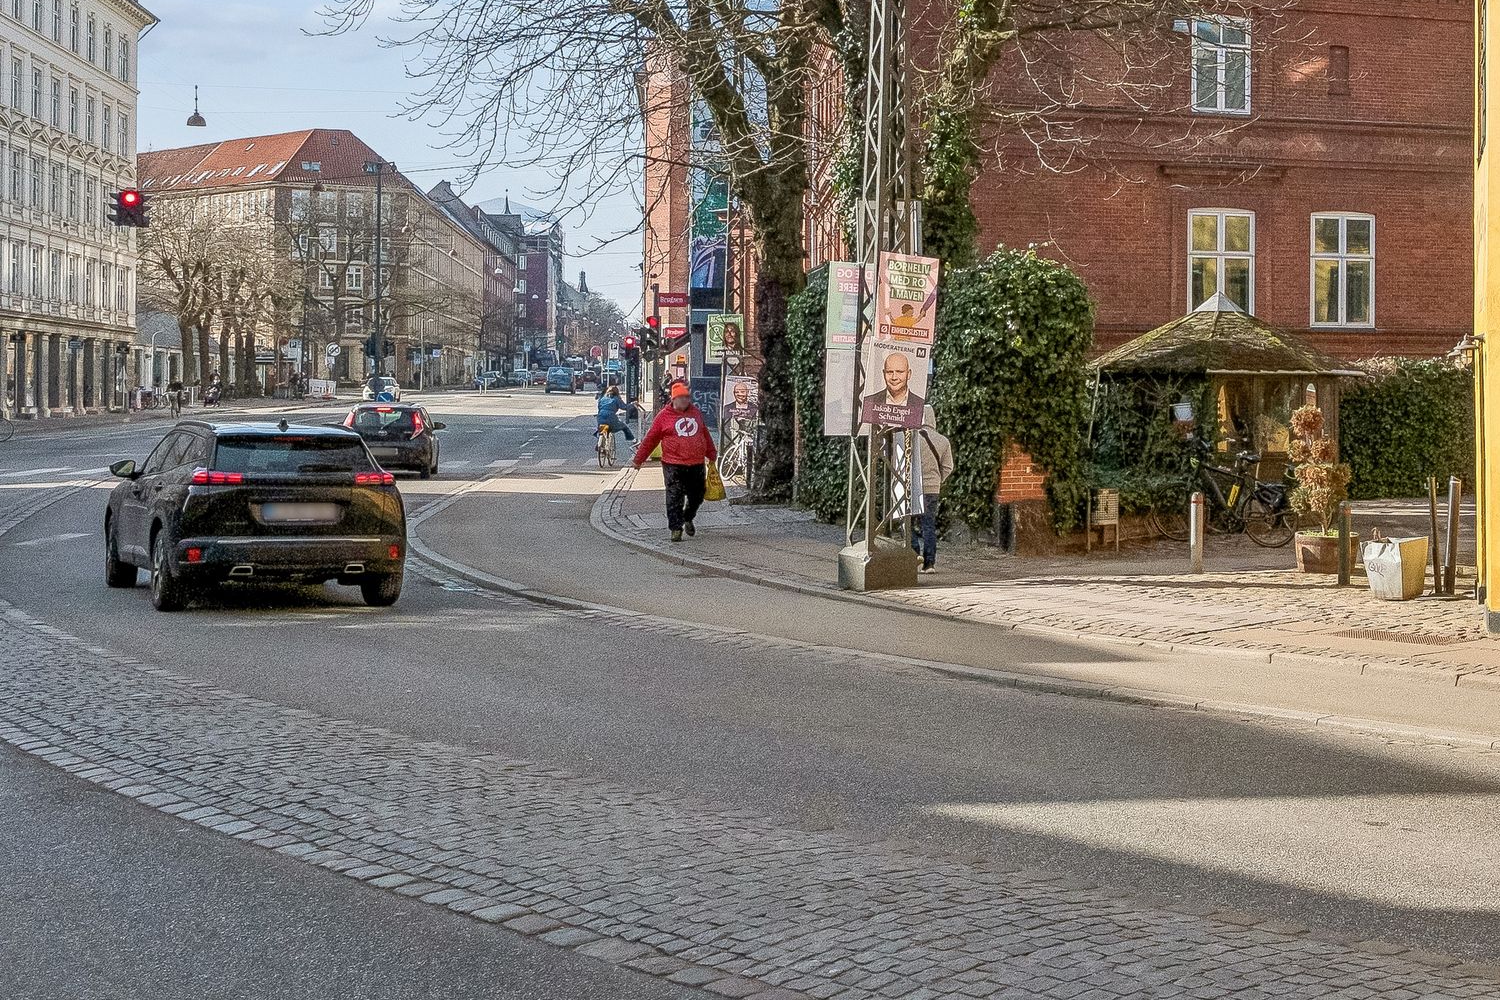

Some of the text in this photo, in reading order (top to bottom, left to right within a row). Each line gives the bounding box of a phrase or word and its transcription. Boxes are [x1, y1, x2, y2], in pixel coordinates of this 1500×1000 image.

[888, 260, 930, 275] BØRNELIV
[890, 274, 926, 288] MED RO
[896, 289, 924, 301] MAVEN
[891, 326, 929, 337] ENHEDSLISTEN
[873, 342, 926, 357] MODERATERNE M
[872, 404, 892, 413] Jakob
[878, 412, 906, 422] Schmidt
